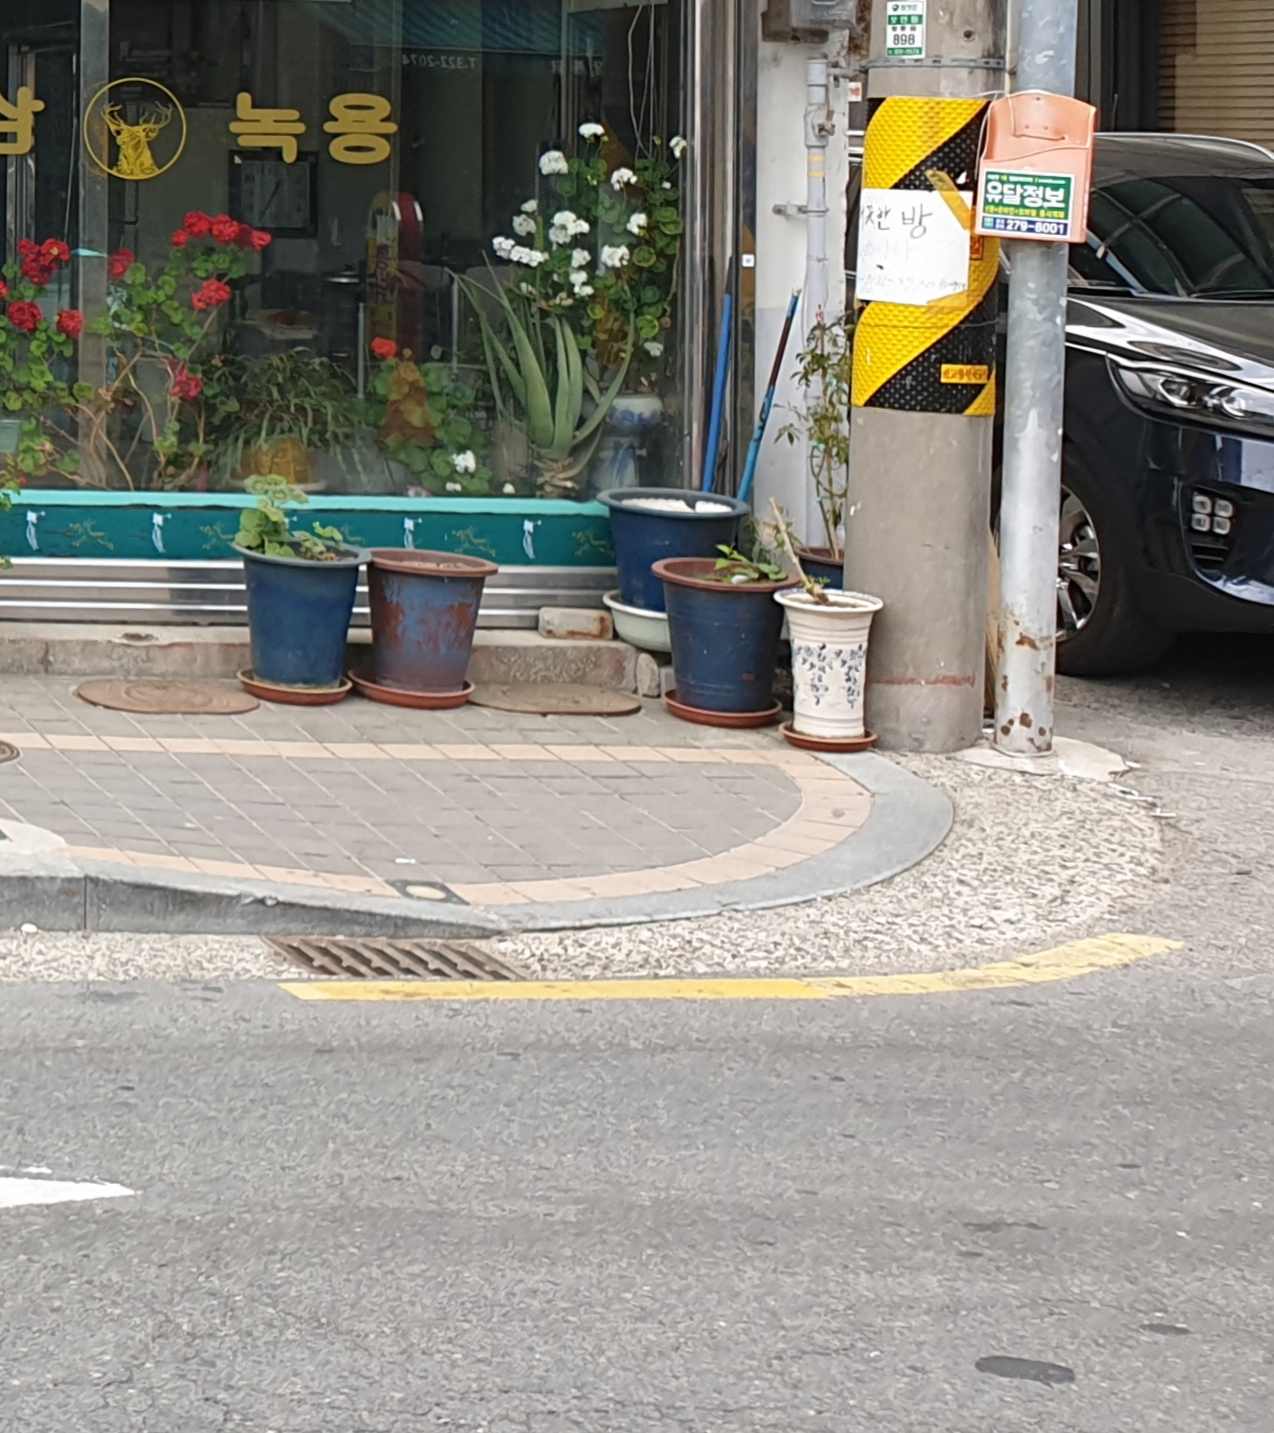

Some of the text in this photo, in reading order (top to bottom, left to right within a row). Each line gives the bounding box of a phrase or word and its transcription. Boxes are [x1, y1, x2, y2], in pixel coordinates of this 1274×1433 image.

[893, 33, 915, 46] 898
[229, 91, 399, 164] 녹용
[986, 180, 1066, 209] 유달정보
[901, 203, 933, 239] 방
